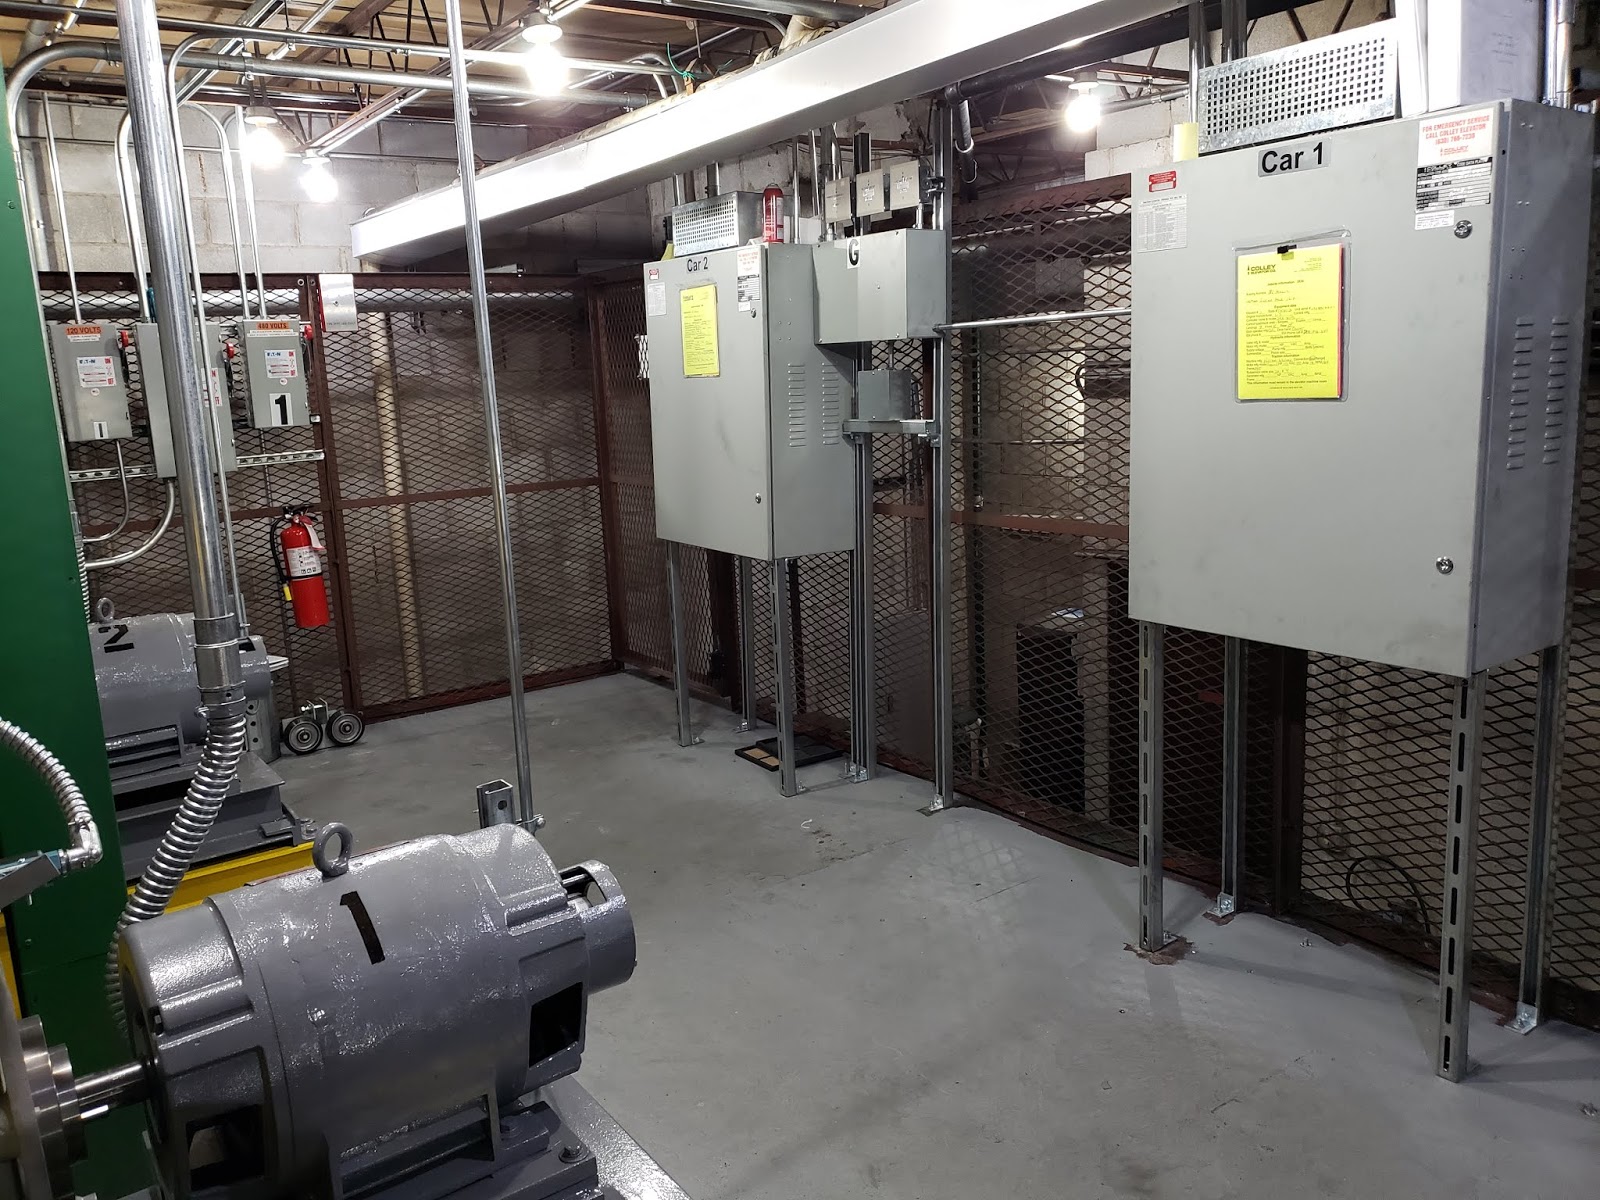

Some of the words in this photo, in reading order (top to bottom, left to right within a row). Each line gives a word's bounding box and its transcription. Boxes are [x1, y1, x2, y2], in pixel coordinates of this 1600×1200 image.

[1422, 125, 1433, 133] FOR
[1433, 119, 1466, 131] EMERGENCY
[1467, 115, 1490, 125] SERVICE
[1425, 131, 1438, 139] CALL
[1439, 128, 1459, 137] COLLEY
[1460, 123, 1487, 134] ELEVATOR
[1261, 150, 1304, 173] Car
[1313, 141, 1323, 165] 1
[848, 238, 860, 266] G
[687, 258, 702, 273] Car
[703, 256, 709, 270] 2
[1250, 264, 1277, 272] COLLEY
[66, 327, 79, 335] 120
[80, 326, 102, 334] VOLTS
[274, 394, 289, 425] 1
[98, 624, 135, 653] 2
[340, 891, 385, 965] 1
